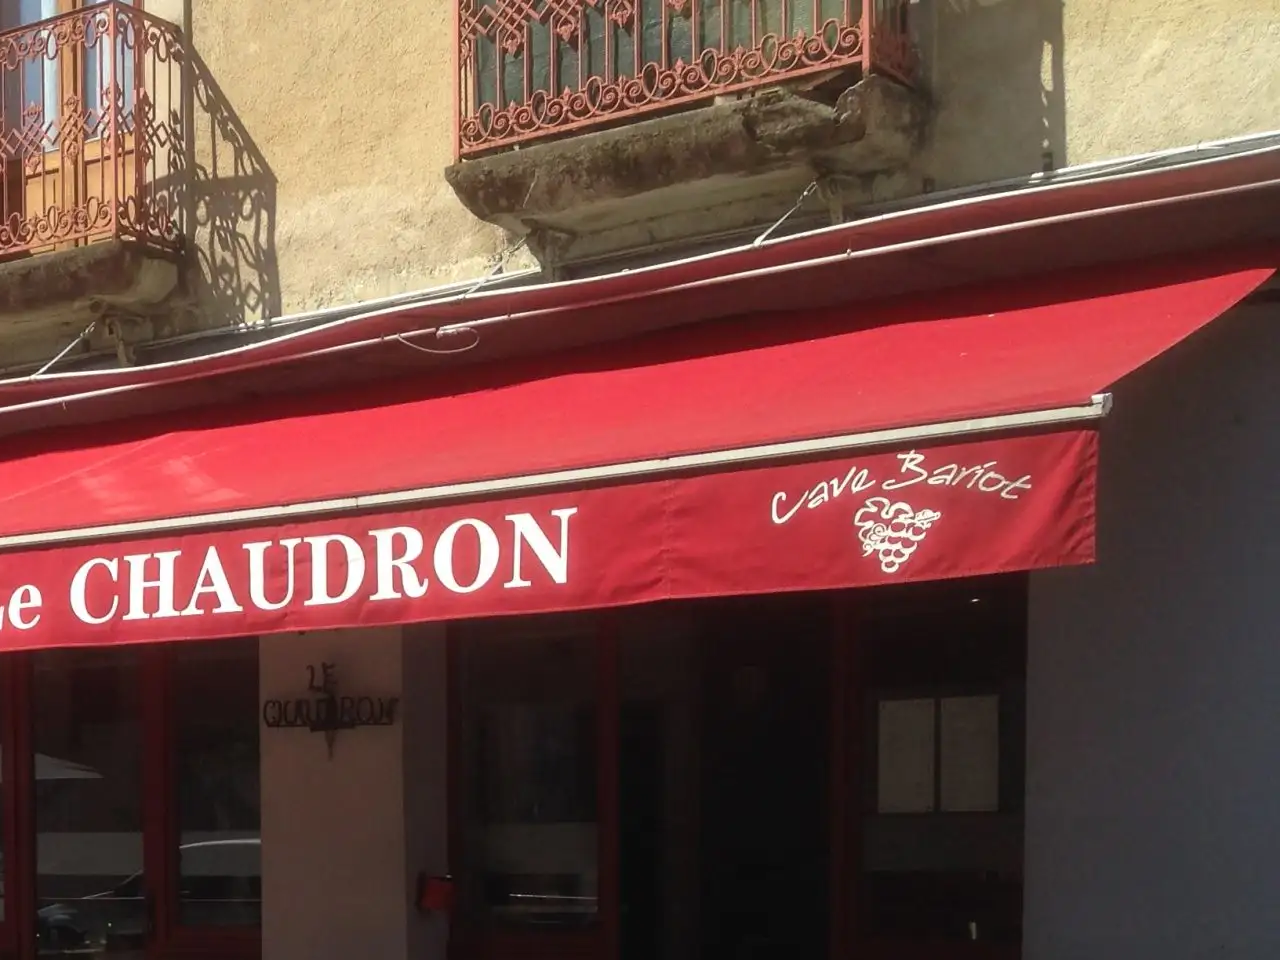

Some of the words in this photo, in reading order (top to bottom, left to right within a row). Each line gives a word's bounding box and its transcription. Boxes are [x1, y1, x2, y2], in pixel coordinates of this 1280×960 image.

[771, 466, 876, 524] Cave
[881, 449, 1032, 499] Bariot
[69, 506, 578, 625] CHAUDRON
